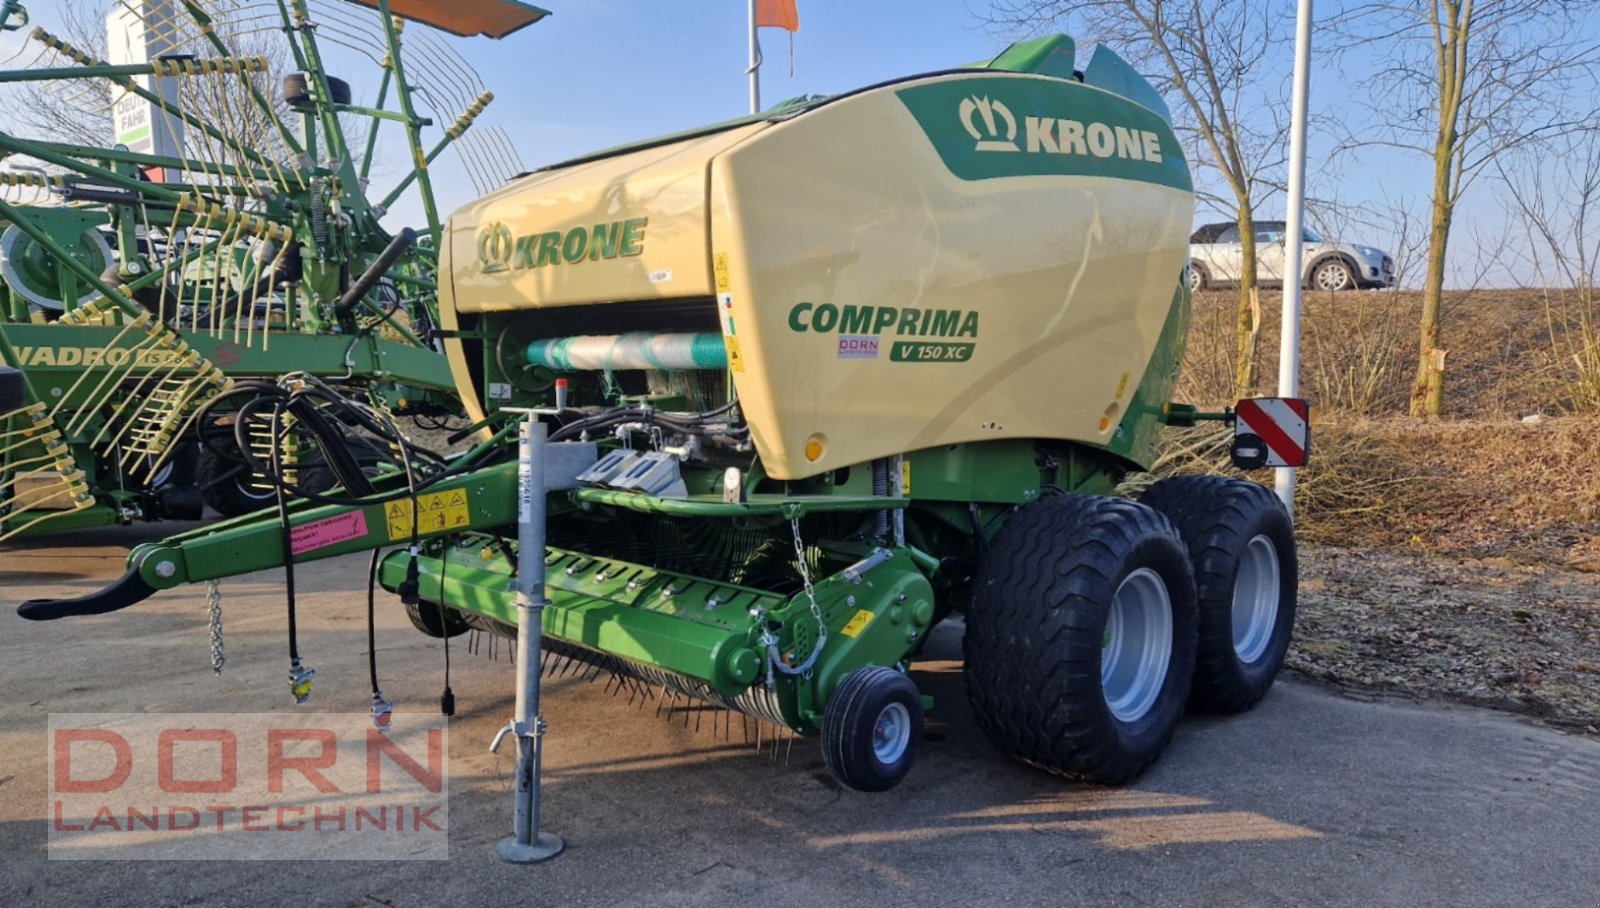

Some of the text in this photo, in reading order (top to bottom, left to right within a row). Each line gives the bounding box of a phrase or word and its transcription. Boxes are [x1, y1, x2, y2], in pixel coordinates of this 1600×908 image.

[121, 109, 146, 130] FAHR
[1025, 116, 1163, 163] KRONE
[513, 216, 648, 270] KRONE
[788, 302, 979, 338] COMPRIMA
[839, 339, 878, 350] DORN
[901, 345, 967, 360] V 150 XC
